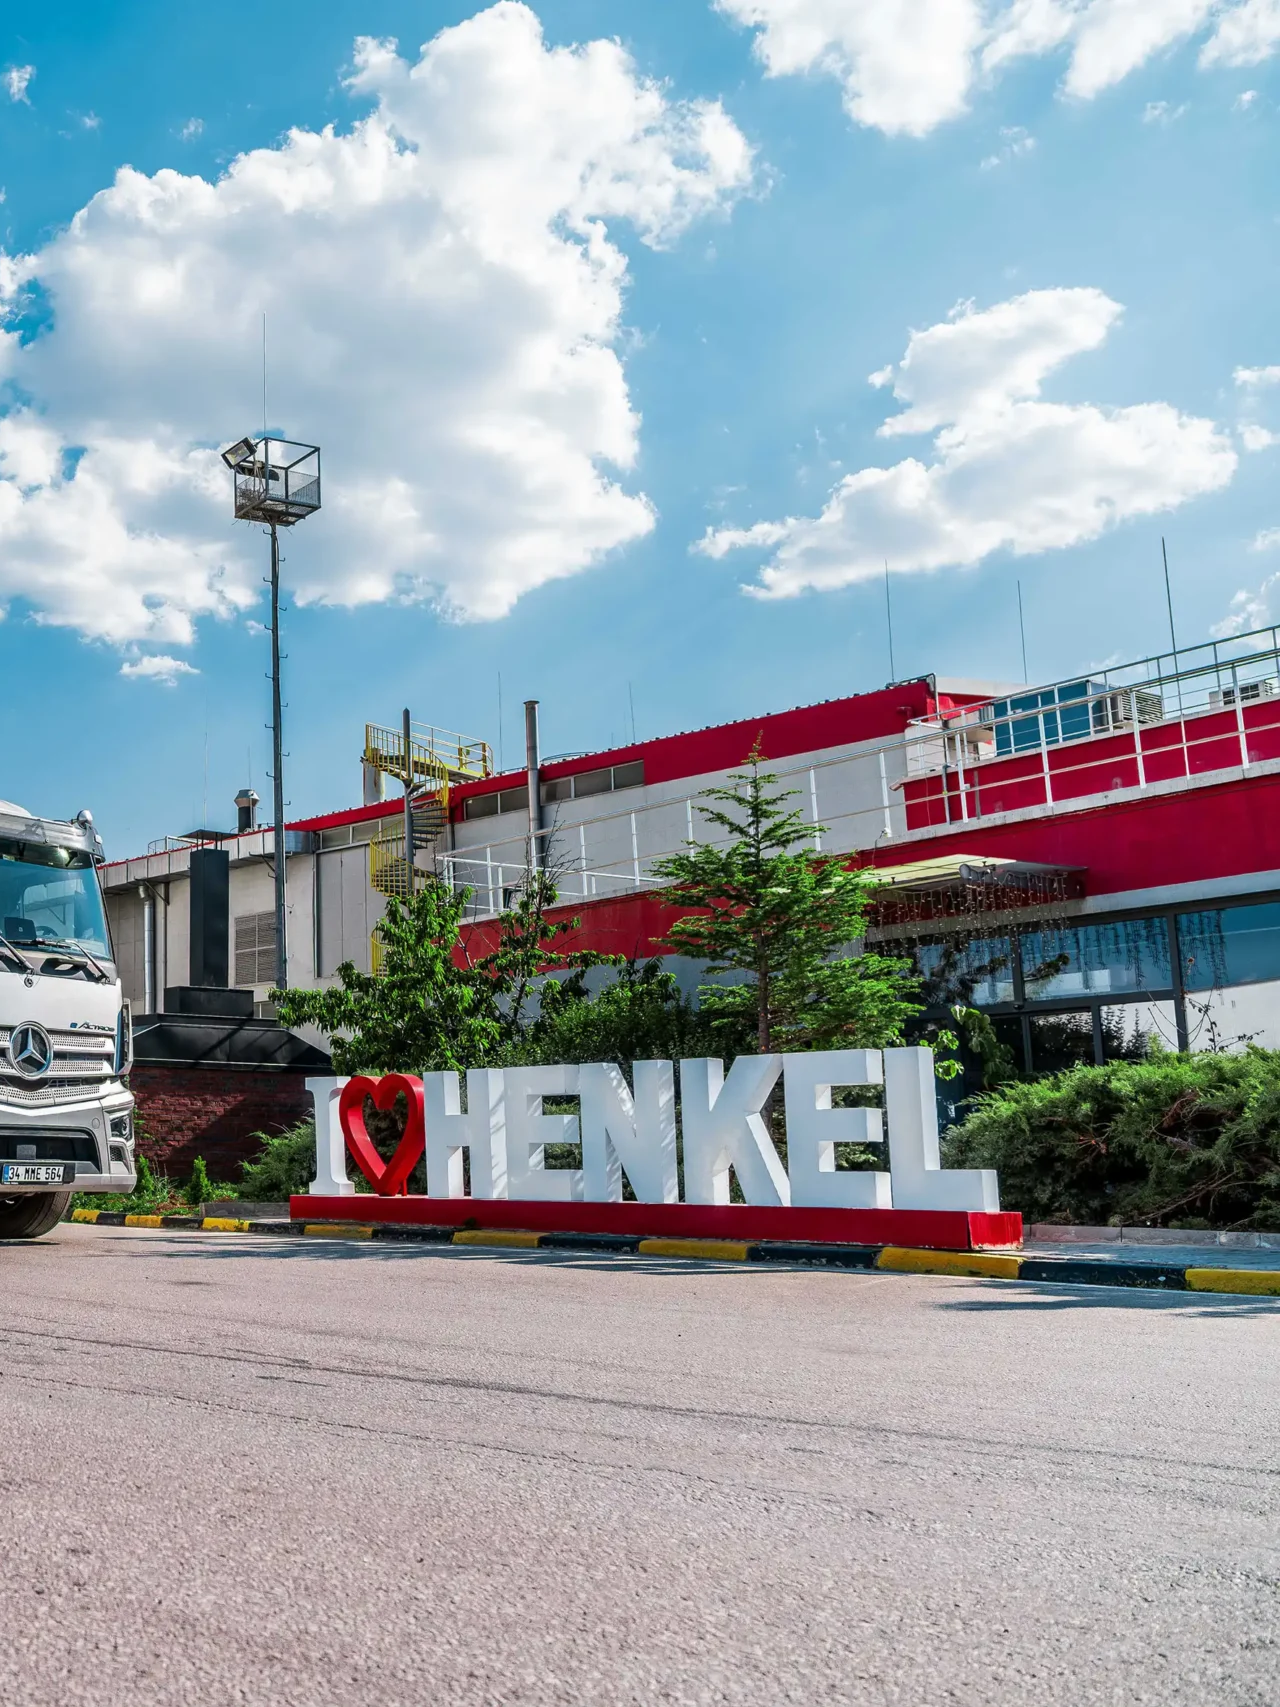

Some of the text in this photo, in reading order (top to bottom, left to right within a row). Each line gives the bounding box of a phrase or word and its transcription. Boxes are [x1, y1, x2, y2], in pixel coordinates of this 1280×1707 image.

[304, 1046, 1000, 1211] I HENKEL
[9, 1167, 61, 1180] 34 MME 564
